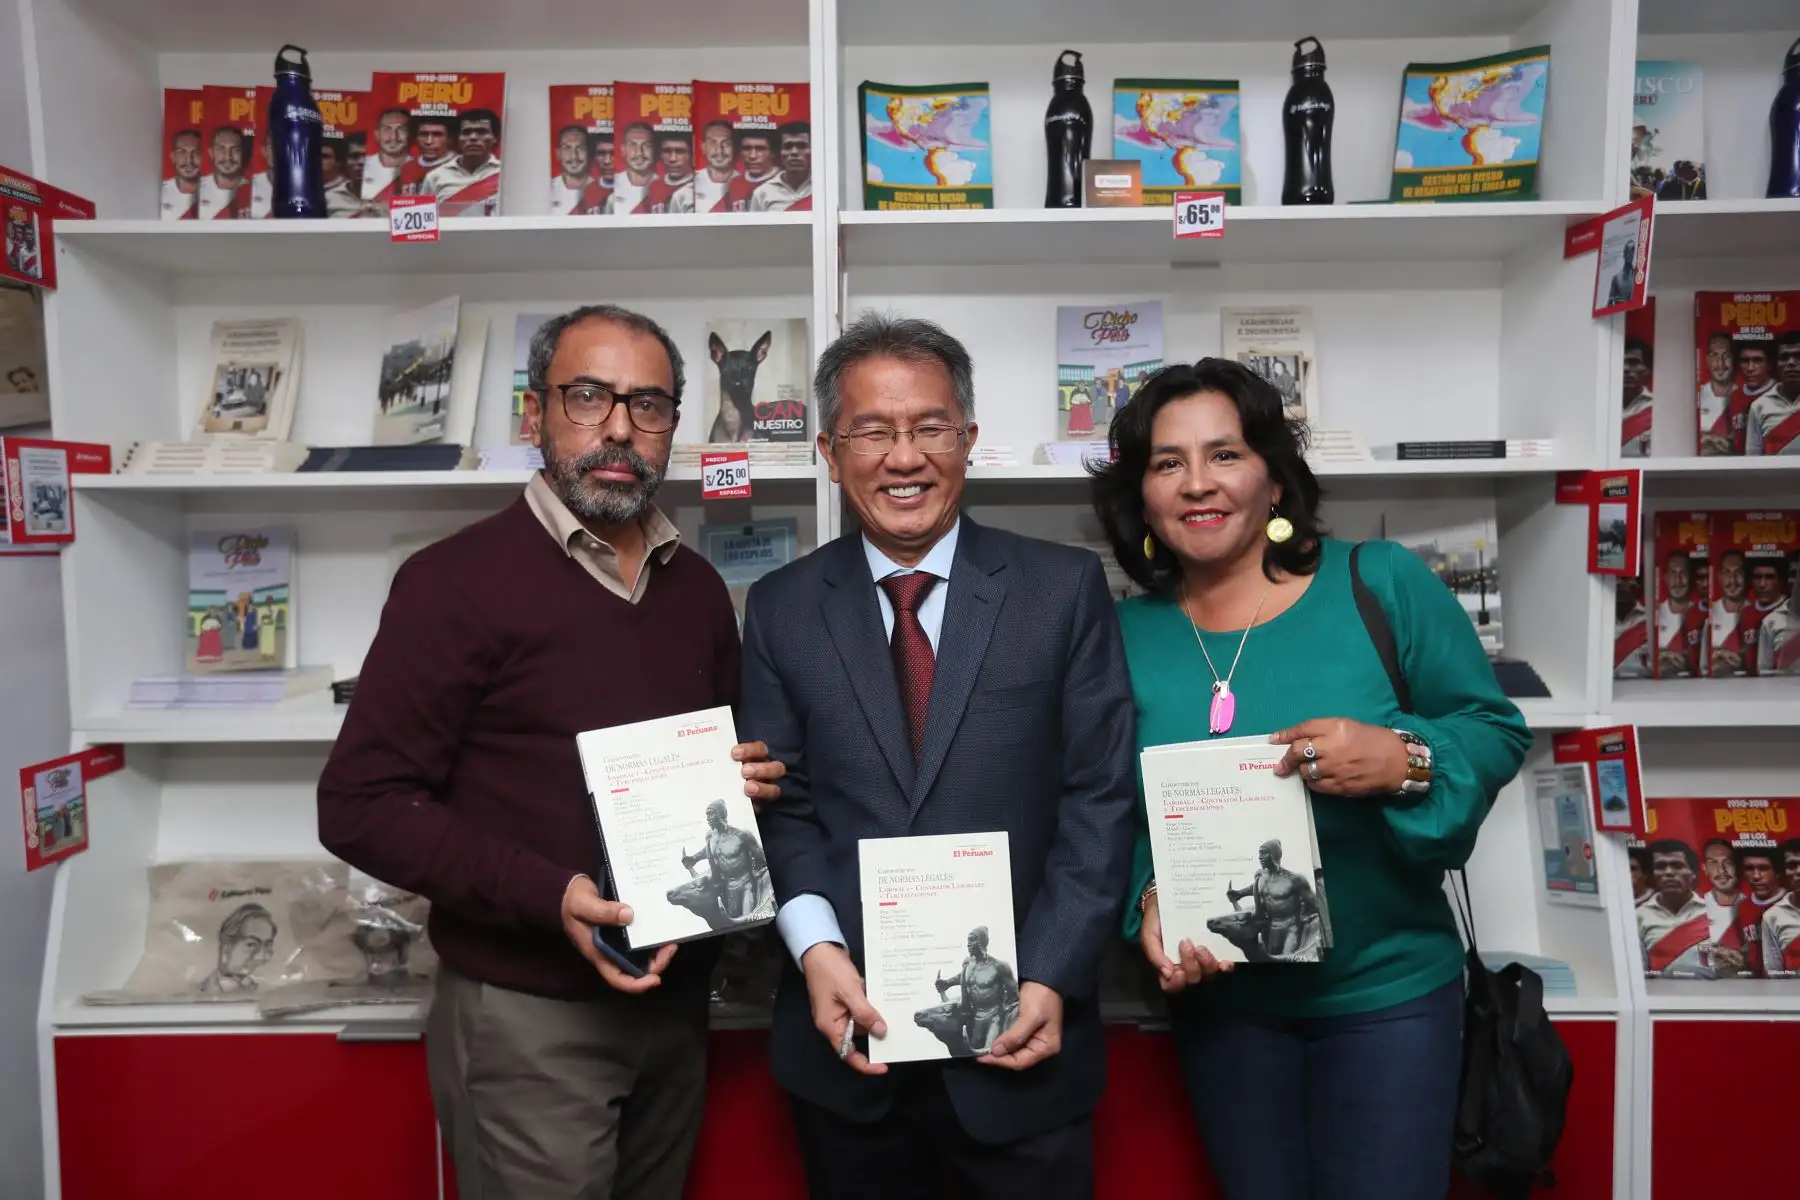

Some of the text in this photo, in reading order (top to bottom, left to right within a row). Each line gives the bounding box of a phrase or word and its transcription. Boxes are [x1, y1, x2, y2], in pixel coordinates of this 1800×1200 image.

[399, 77, 474, 104] PERÚ
[719, 88, 789, 116] PERÚ
[1084, 310, 1138, 330] Dicho
[1721, 296, 1787, 327] PERÚ
[754, 399, 803, 420] CAN
[753, 419, 804, 430] NUESTRO
[719, 488, 747, 496] ESPECIAL
[1733, 514, 1796, 544] PERÚ
[677, 724, 718, 738] El Peruano
[1173, 787, 1205, 797] NORMAS
[1714, 801, 1788, 833] PERÚ
[953, 849, 994, 858] El Peruano
[1731, 840, 1777, 848] MUNDIALES
